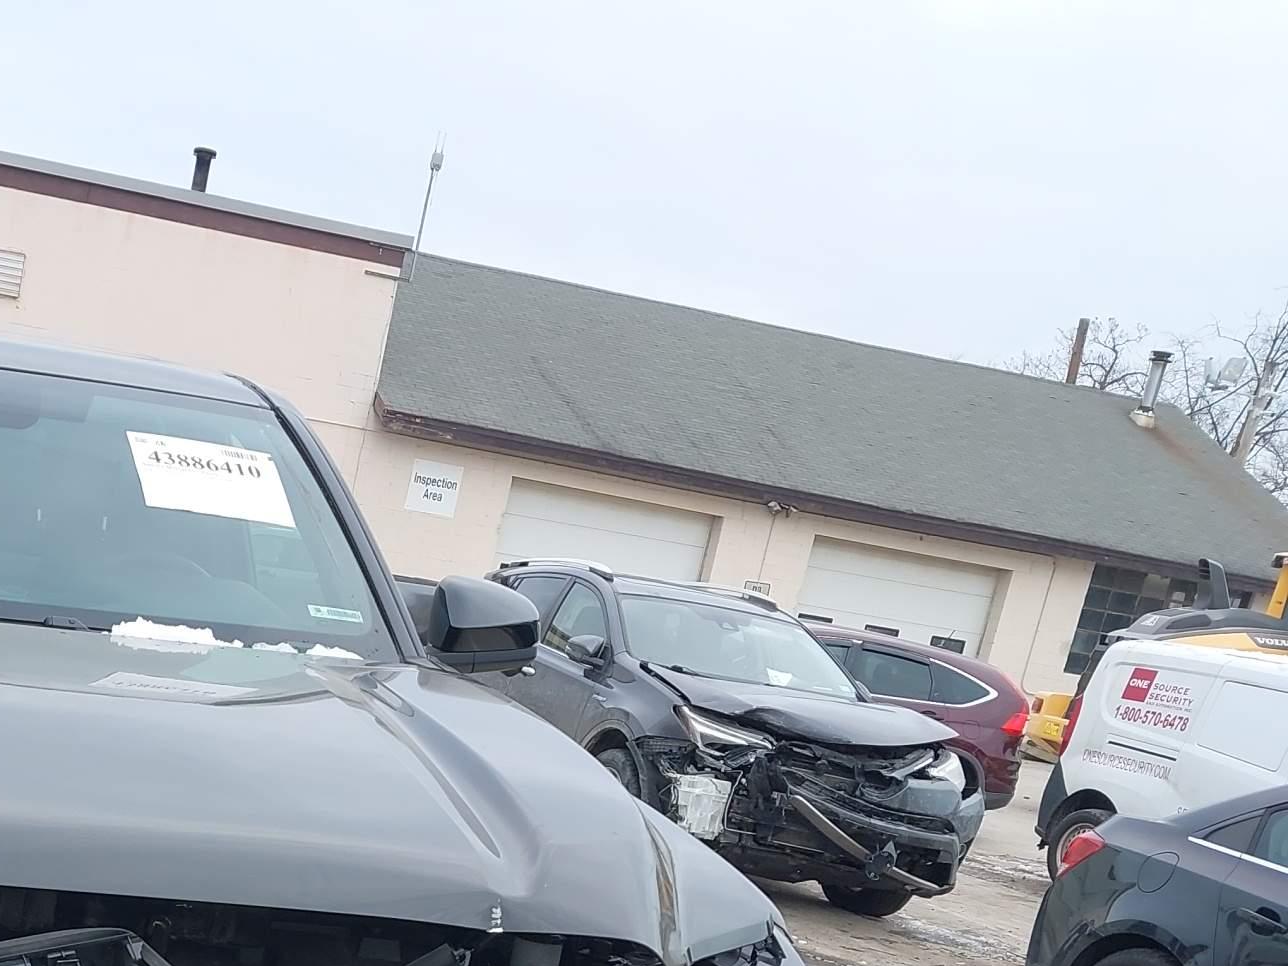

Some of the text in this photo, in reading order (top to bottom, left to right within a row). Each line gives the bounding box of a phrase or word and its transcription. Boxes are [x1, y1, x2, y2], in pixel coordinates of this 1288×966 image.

[148, 450, 261, 478] 43886410
[414, 472, 458, 491] Inspection
[422, 488, 443, 502] Area
[1129, 678, 1191, 696] ONE SOURCE
[1148, 692, 1194, 708] SECURITY
[1114, 704, 1190, 732] 1-800-570-6478
